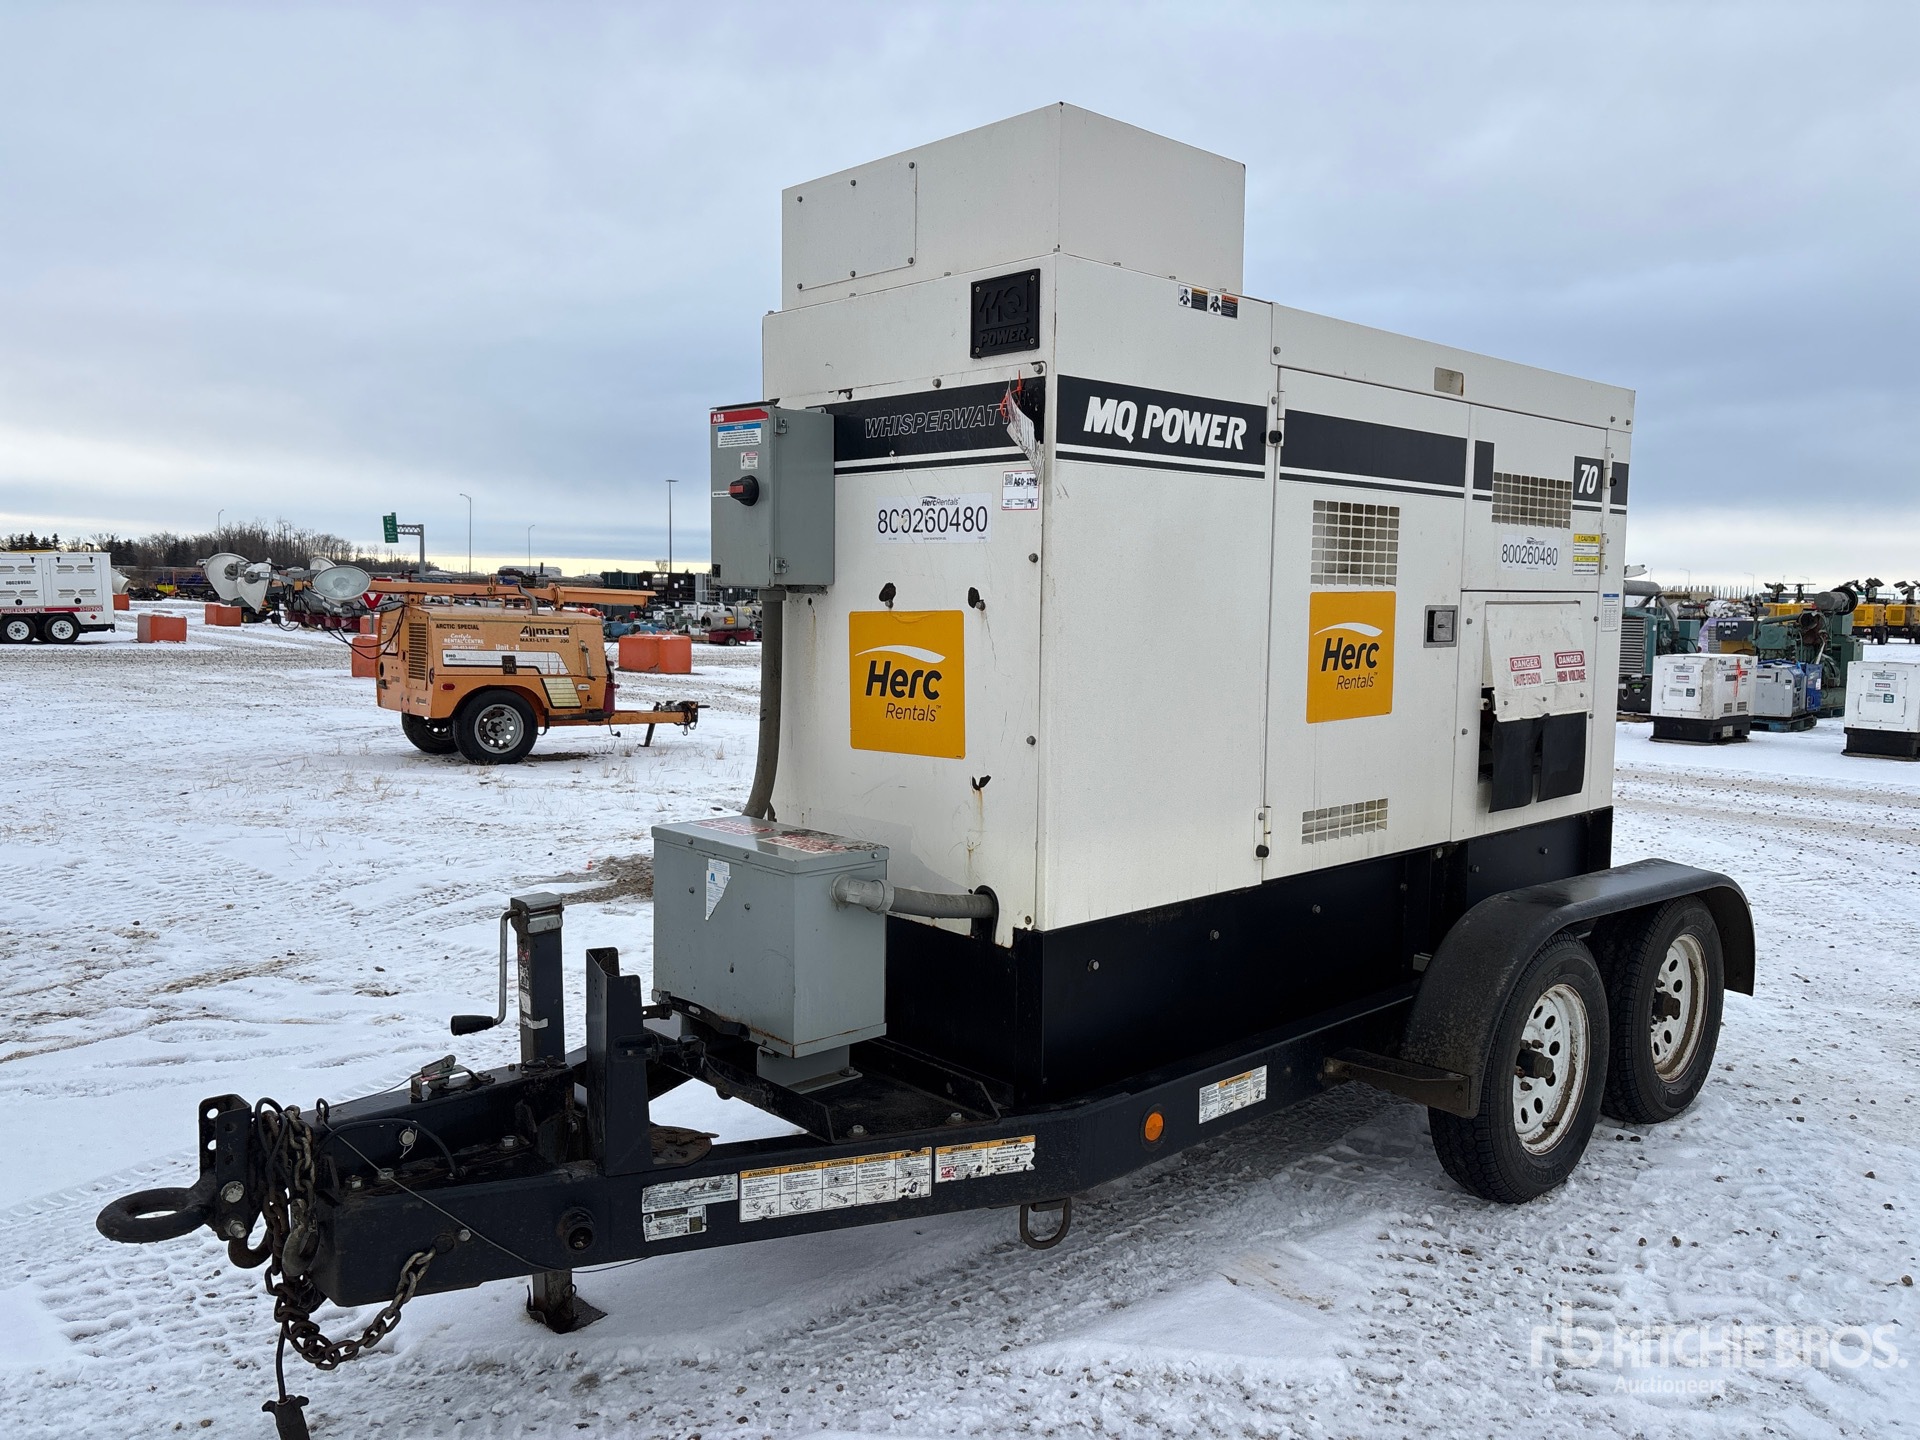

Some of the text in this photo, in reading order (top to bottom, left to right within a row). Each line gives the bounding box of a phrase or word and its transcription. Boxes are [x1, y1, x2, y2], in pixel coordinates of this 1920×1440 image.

[979, 327, 1028, 348] POWER
[712, 413, 725, 423] ABB
[1083, 396, 1138, 444] MQ
[1142, 404, 1247, 450] POWER
[1578, 463, 1599, 495] 70
[877, 506, 988, 534] 800260480
[1501, 544, 1559, 566] 800260480
[457, 623, 479, 631] SPECIAL
[520, 625, 570, 637] Allmand
[495, 643, 509, 651] Unit
[1320, 637, 1380, 672] Herc
[1513, 659, 1538, 668] DANGER
[1558, 655, 1582, 665] DANGER
[866, 660, 943, 700] Herc
[1568, 669, 1586, 682] VOLTAGE
